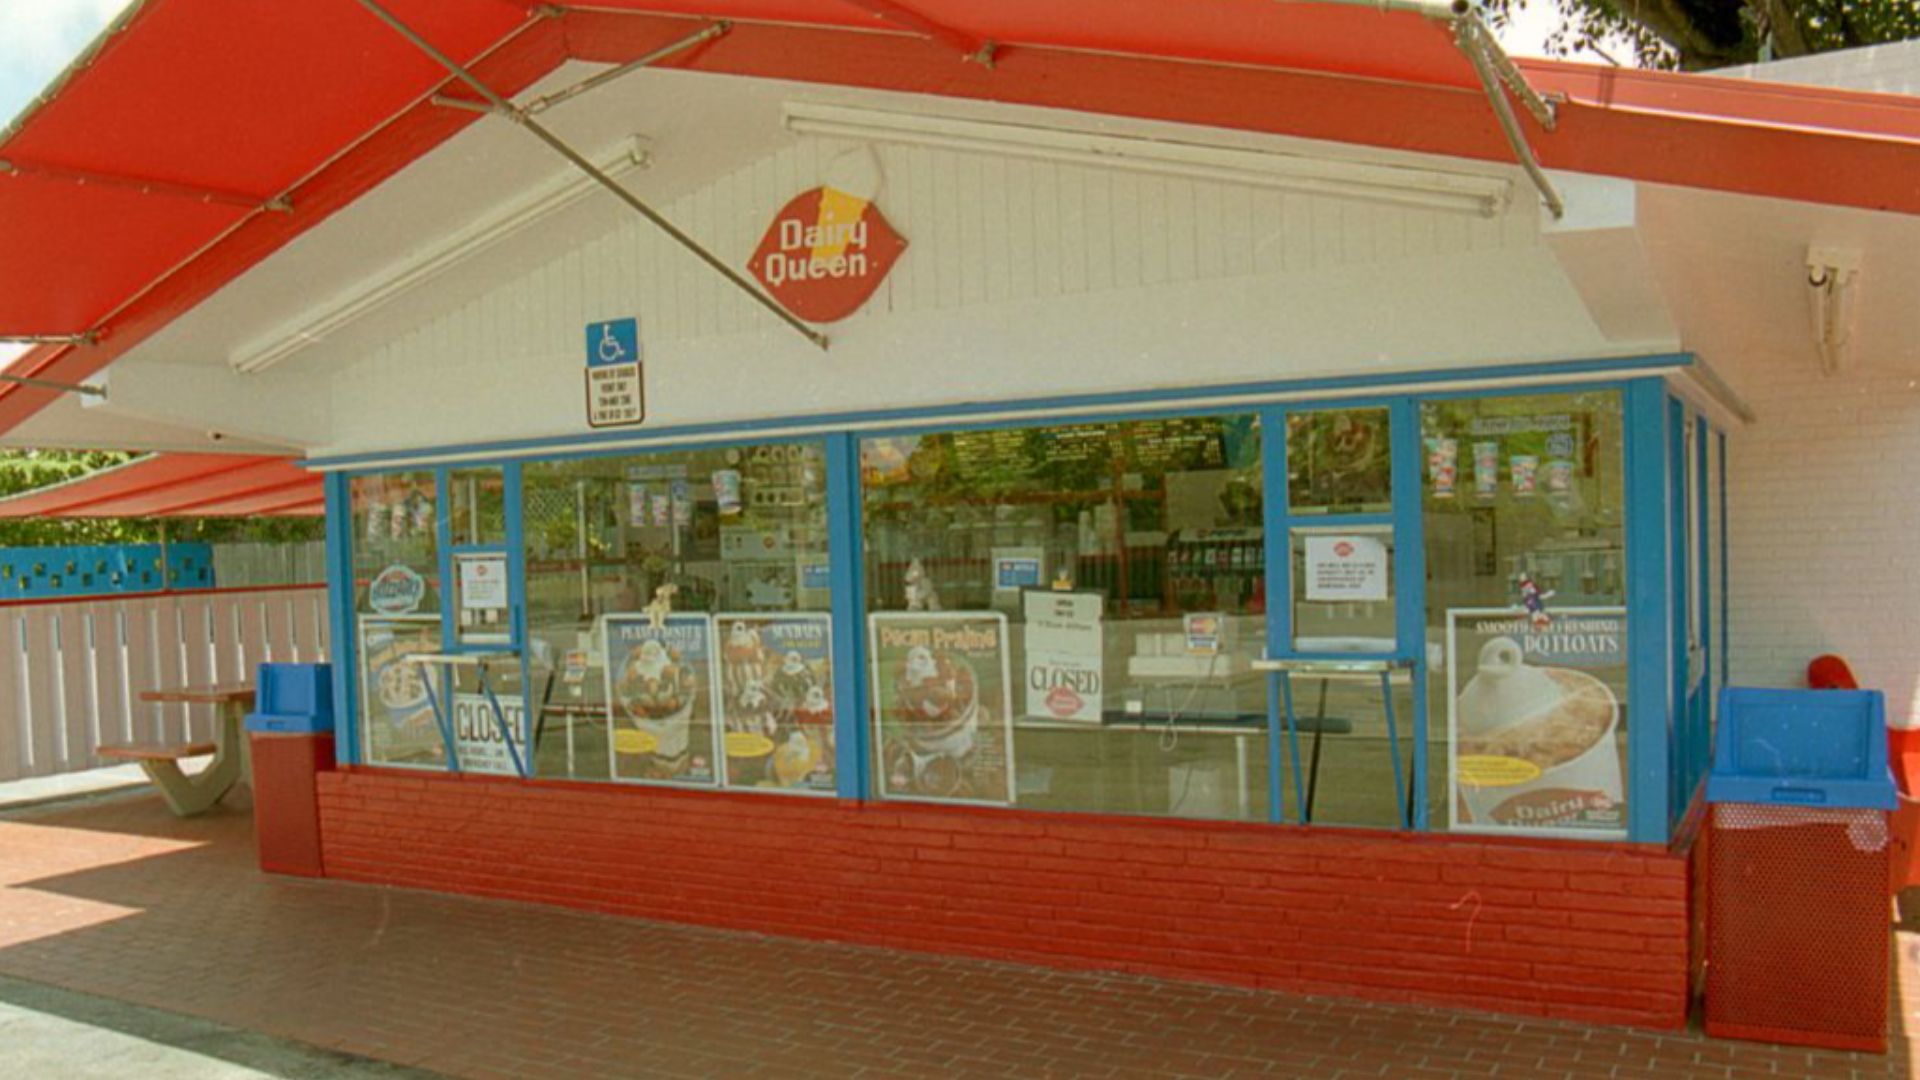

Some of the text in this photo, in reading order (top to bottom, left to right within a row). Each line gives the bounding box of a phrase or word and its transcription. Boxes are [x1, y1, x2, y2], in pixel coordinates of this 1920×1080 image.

[779, 218, 868, 251] Dairy
[764, 251, 868, 287] Queen
[1030, 665, 1100, 695] CLOSED
